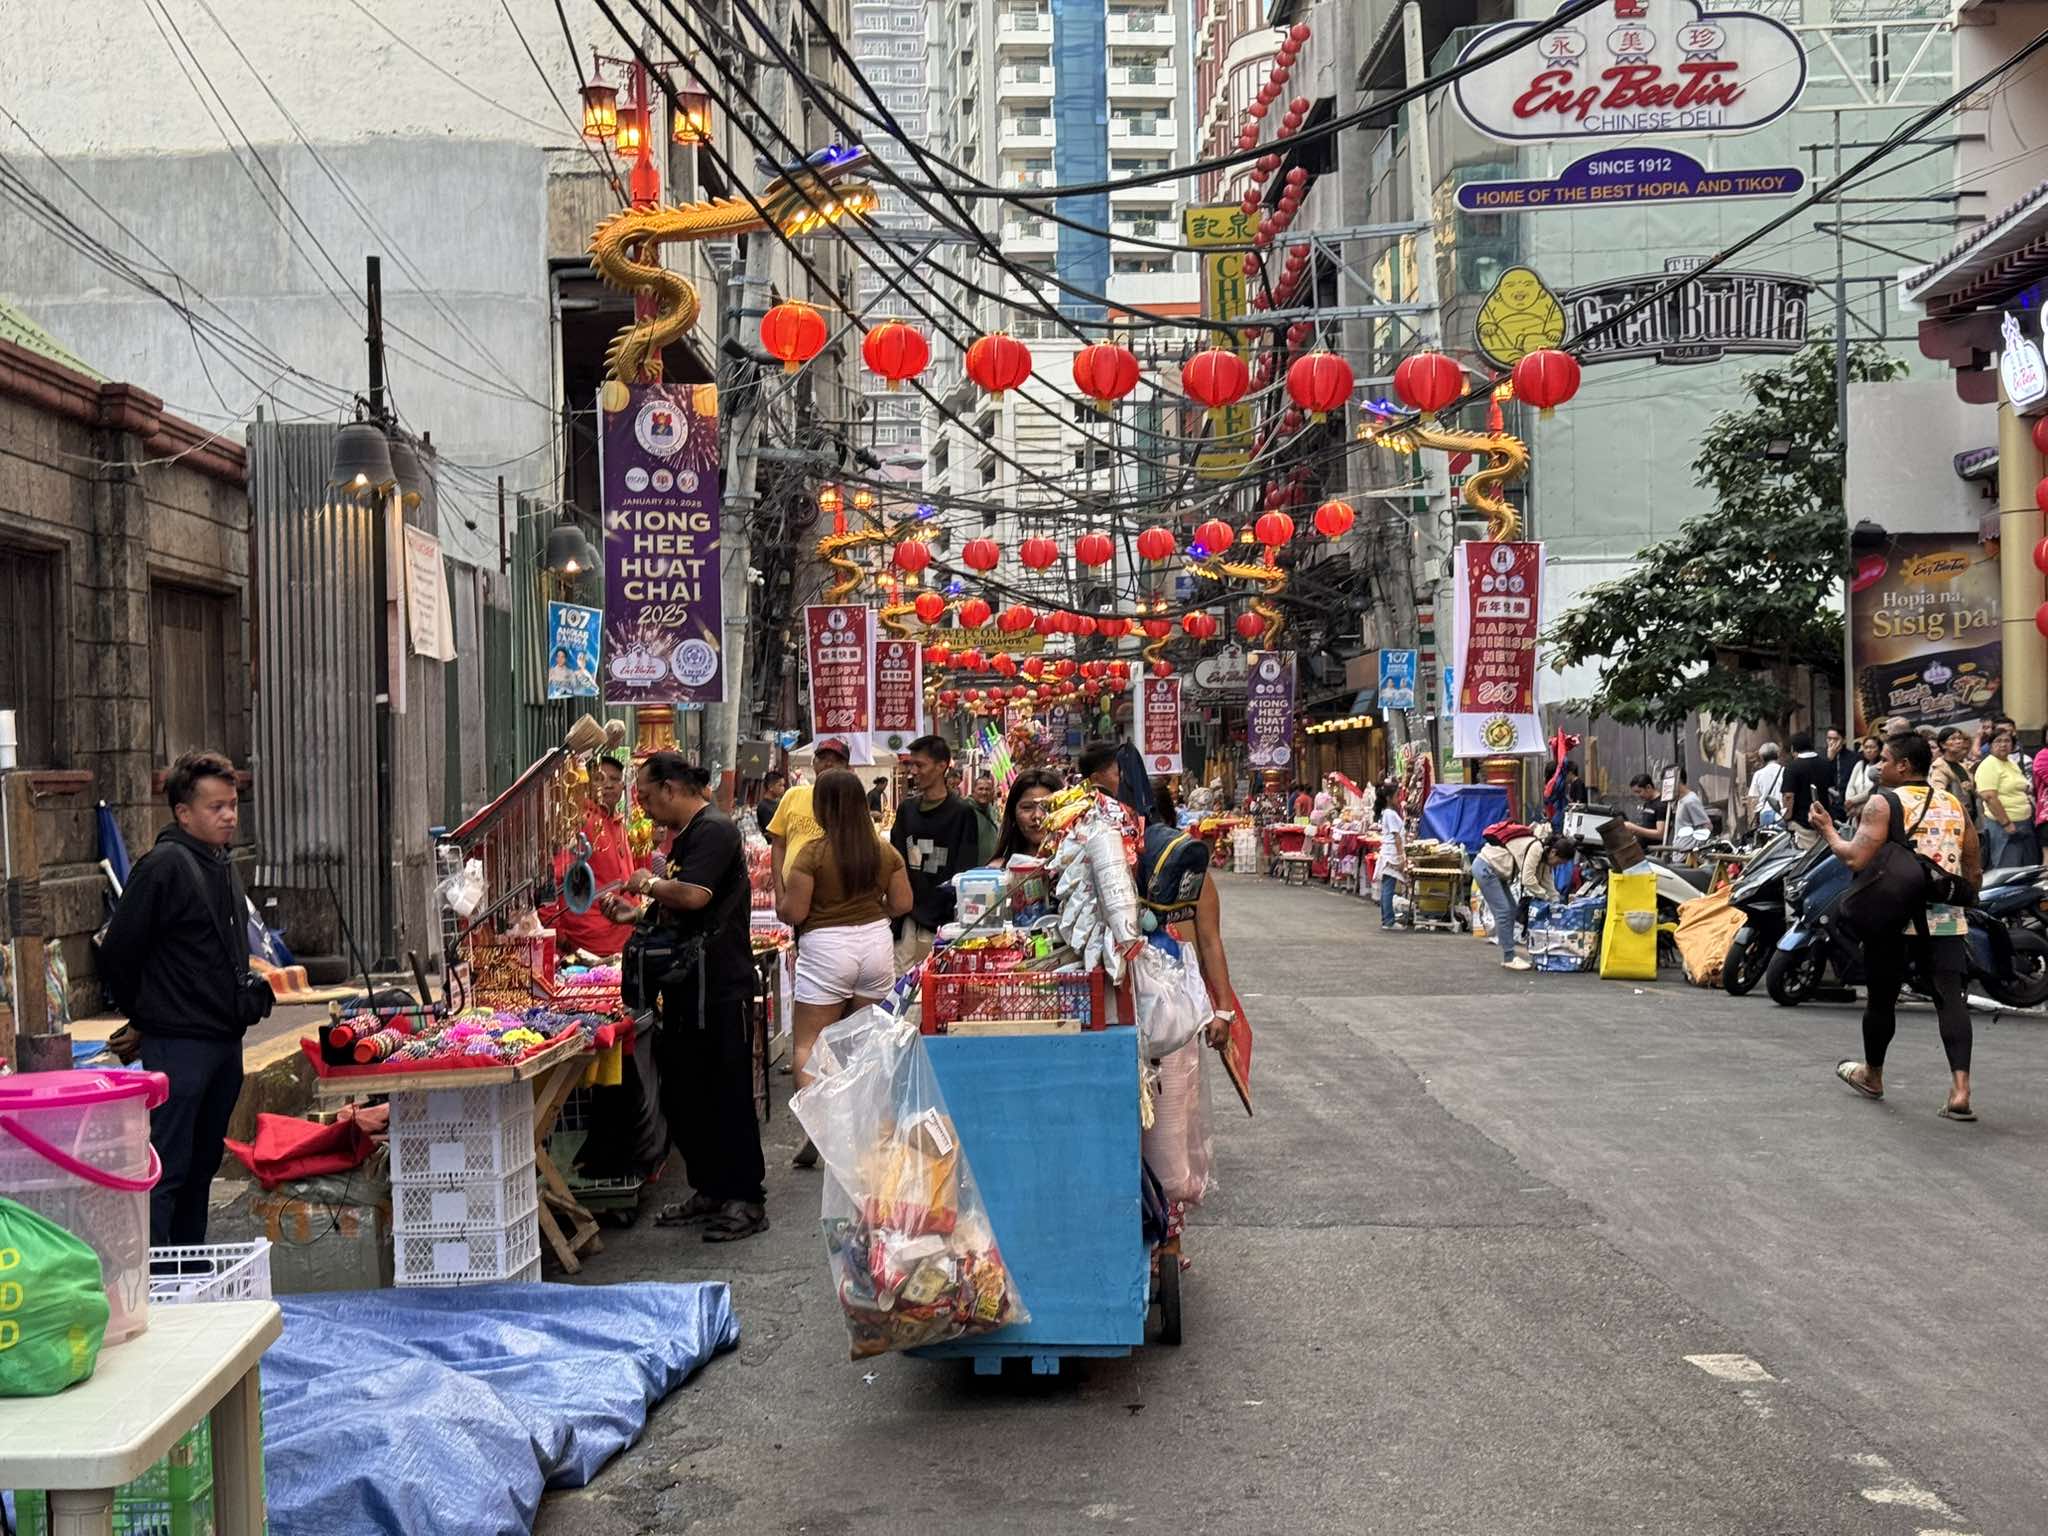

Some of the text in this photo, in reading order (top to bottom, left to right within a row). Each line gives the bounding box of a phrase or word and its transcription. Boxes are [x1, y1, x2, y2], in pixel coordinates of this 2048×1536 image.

[1551, 35, 1574, 57] 永
[1619, 30, 1645, 52] 美
[1689, 28, 1715, 48] 珍
[1582, 109, 1723, 132] CHINESE DELI
[1587, 158, 1672, 176] SINCE 1912
[1475, 176, 1786, 205] HOME OF THE BEST HOPIA AND TIKOY
[1678, 278, 1808, 343] Buddha
[621, 498, 663, 506] JANUARY
[610, 510, 711, 532] KIONG
[633, 534, 695, 555] HEE
[621, 558, 705, 579] HUAT
[623, 581, 701, 601] CHAI
[1882, 589, 1935, 610] Hopia
[558, 608, 591, 629] 107
[637, 603, 688, 628] 2025
[1872, 600, 1998, 641] Sisig pa!
[1475, 622, 1528, 636] HAPPY
[1386, 652, 1409, 664] 107
[820, 665, 860, 676] HAPPY
[1248, 700, 1289, 708] KIONG
[1258, 709, 1282, 717] HEE
[1254, 717, 1287, 725] HUAT
[1254, 726, 1285, 734] CHAI
